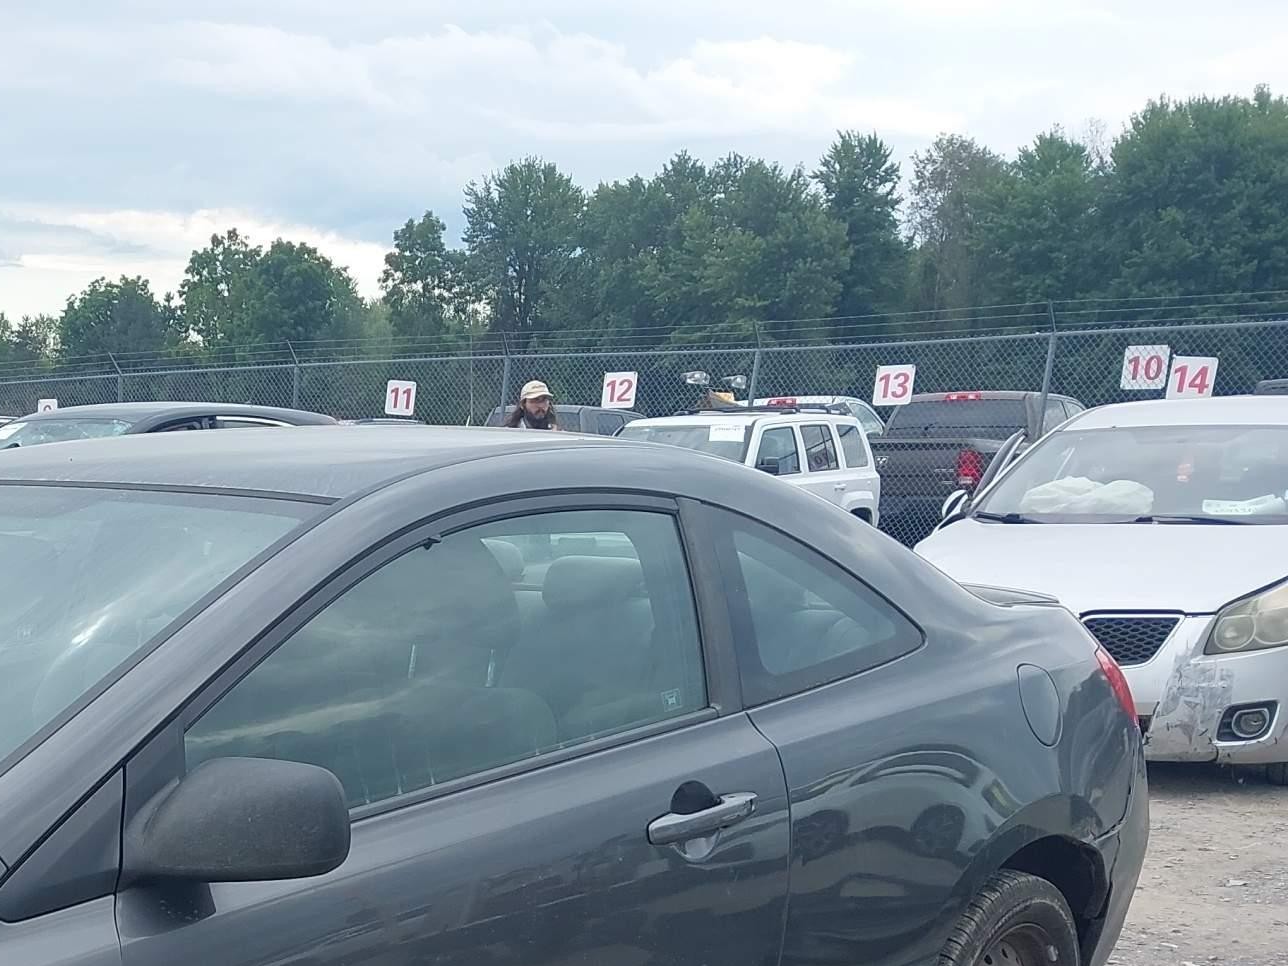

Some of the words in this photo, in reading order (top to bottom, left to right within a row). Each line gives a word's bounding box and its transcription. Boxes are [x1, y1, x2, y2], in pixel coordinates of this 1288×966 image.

[1128, 355, 1163, 381] 10
[1174, 365, 1209, 394] 14
[391, 388, 411, 409] 11
[606, 378, 633, 403] 12
[879, 372, 910, 399] 13
